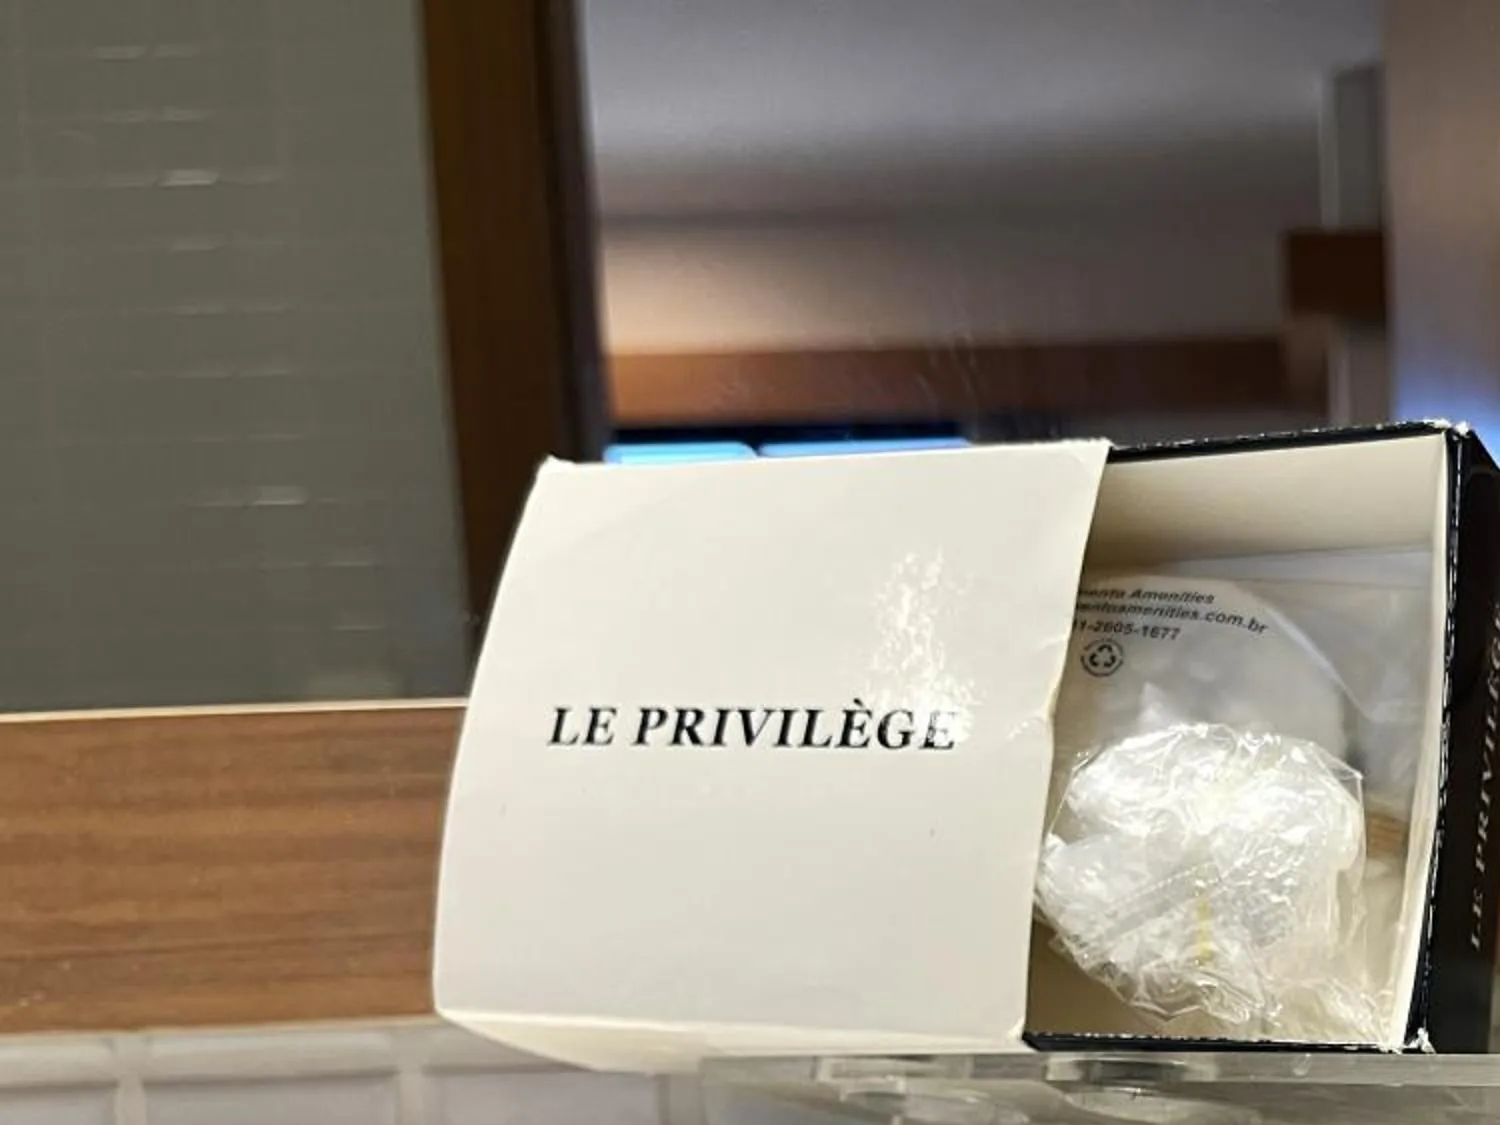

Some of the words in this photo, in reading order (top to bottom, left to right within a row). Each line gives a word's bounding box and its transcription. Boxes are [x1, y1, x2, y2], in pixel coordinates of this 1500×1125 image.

[1130, 587, 1216, 605] Amenities
[547, 706, 617, 747] LE
[631, 697, 959, 750] PRIVILÈGE
